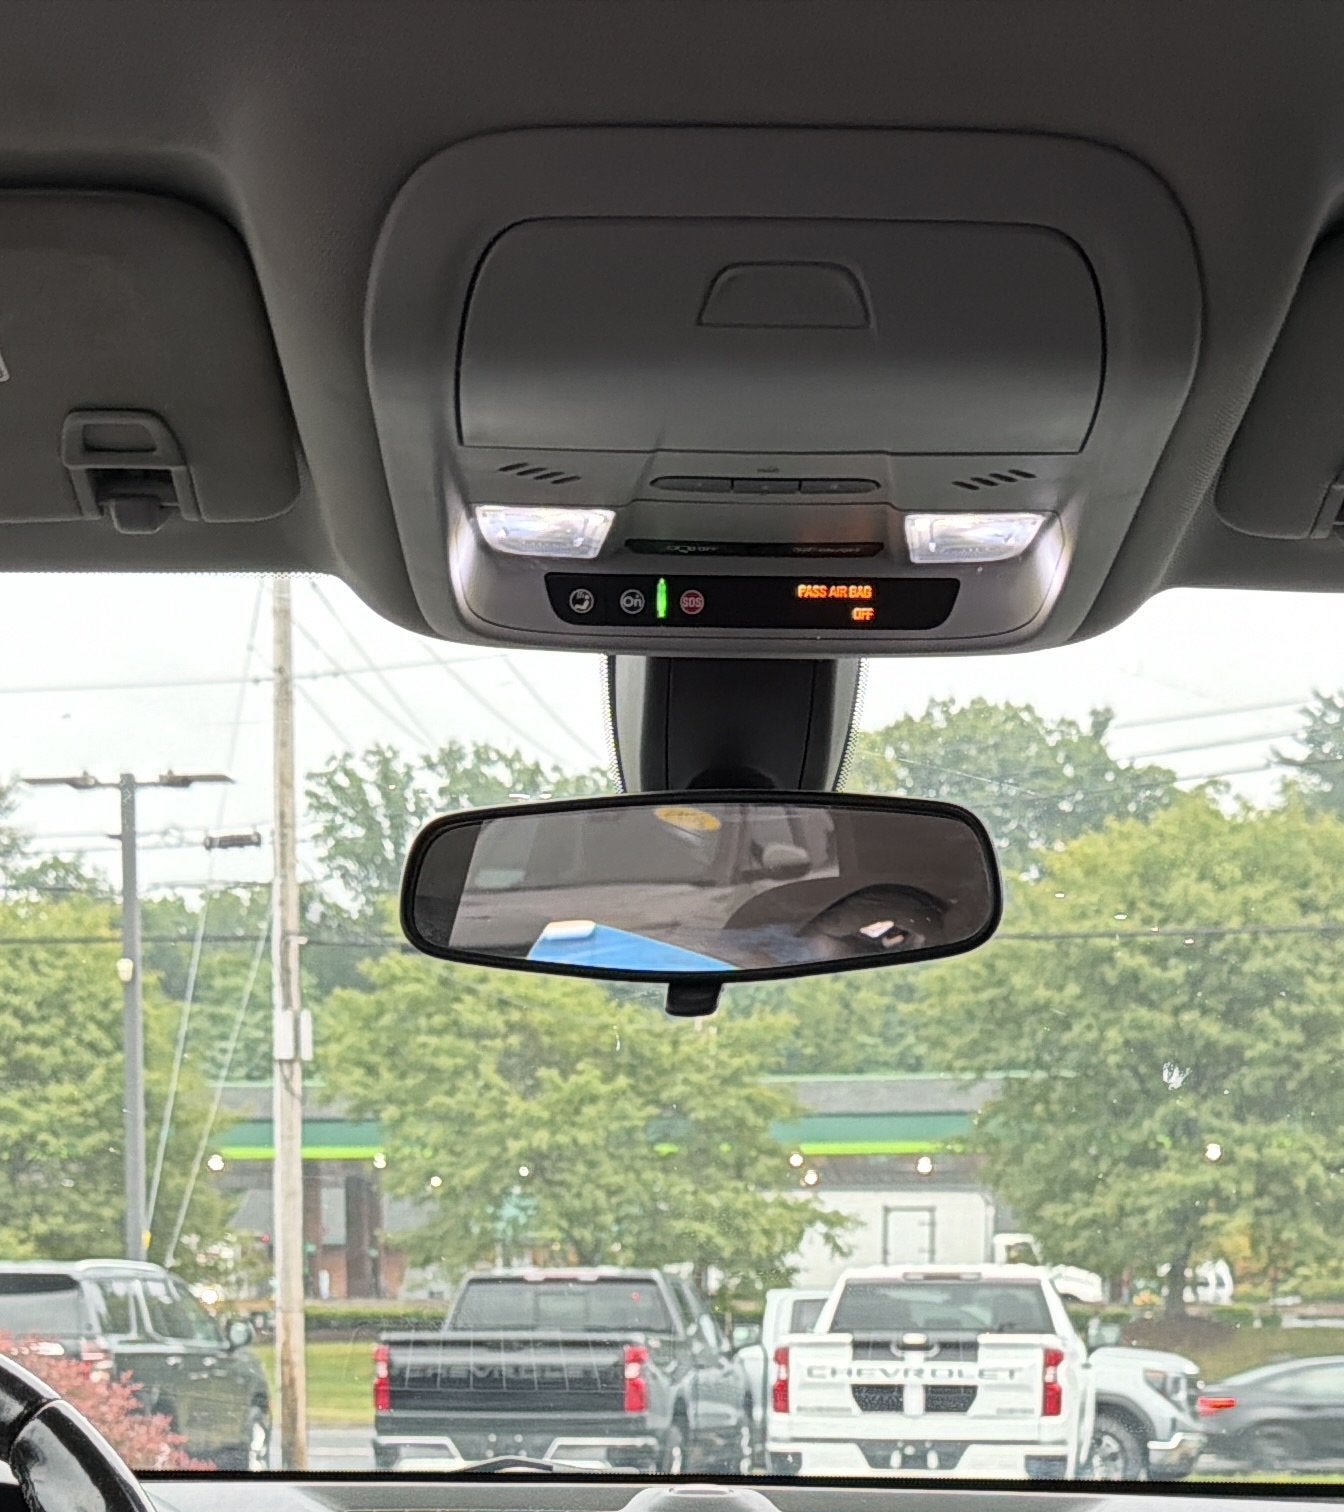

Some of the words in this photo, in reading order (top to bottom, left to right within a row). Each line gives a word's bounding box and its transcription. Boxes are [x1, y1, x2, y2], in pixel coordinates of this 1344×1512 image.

[798, 584, 827, 598] PASS
[828, 584, 847, 598] AIR
[849, 585, 872, 599] BAG
[681, 596, 703, 609] SOS
[852, 606, 875, 621] OFF
[806, 1365, 1018, 1381] CHEVROLET
